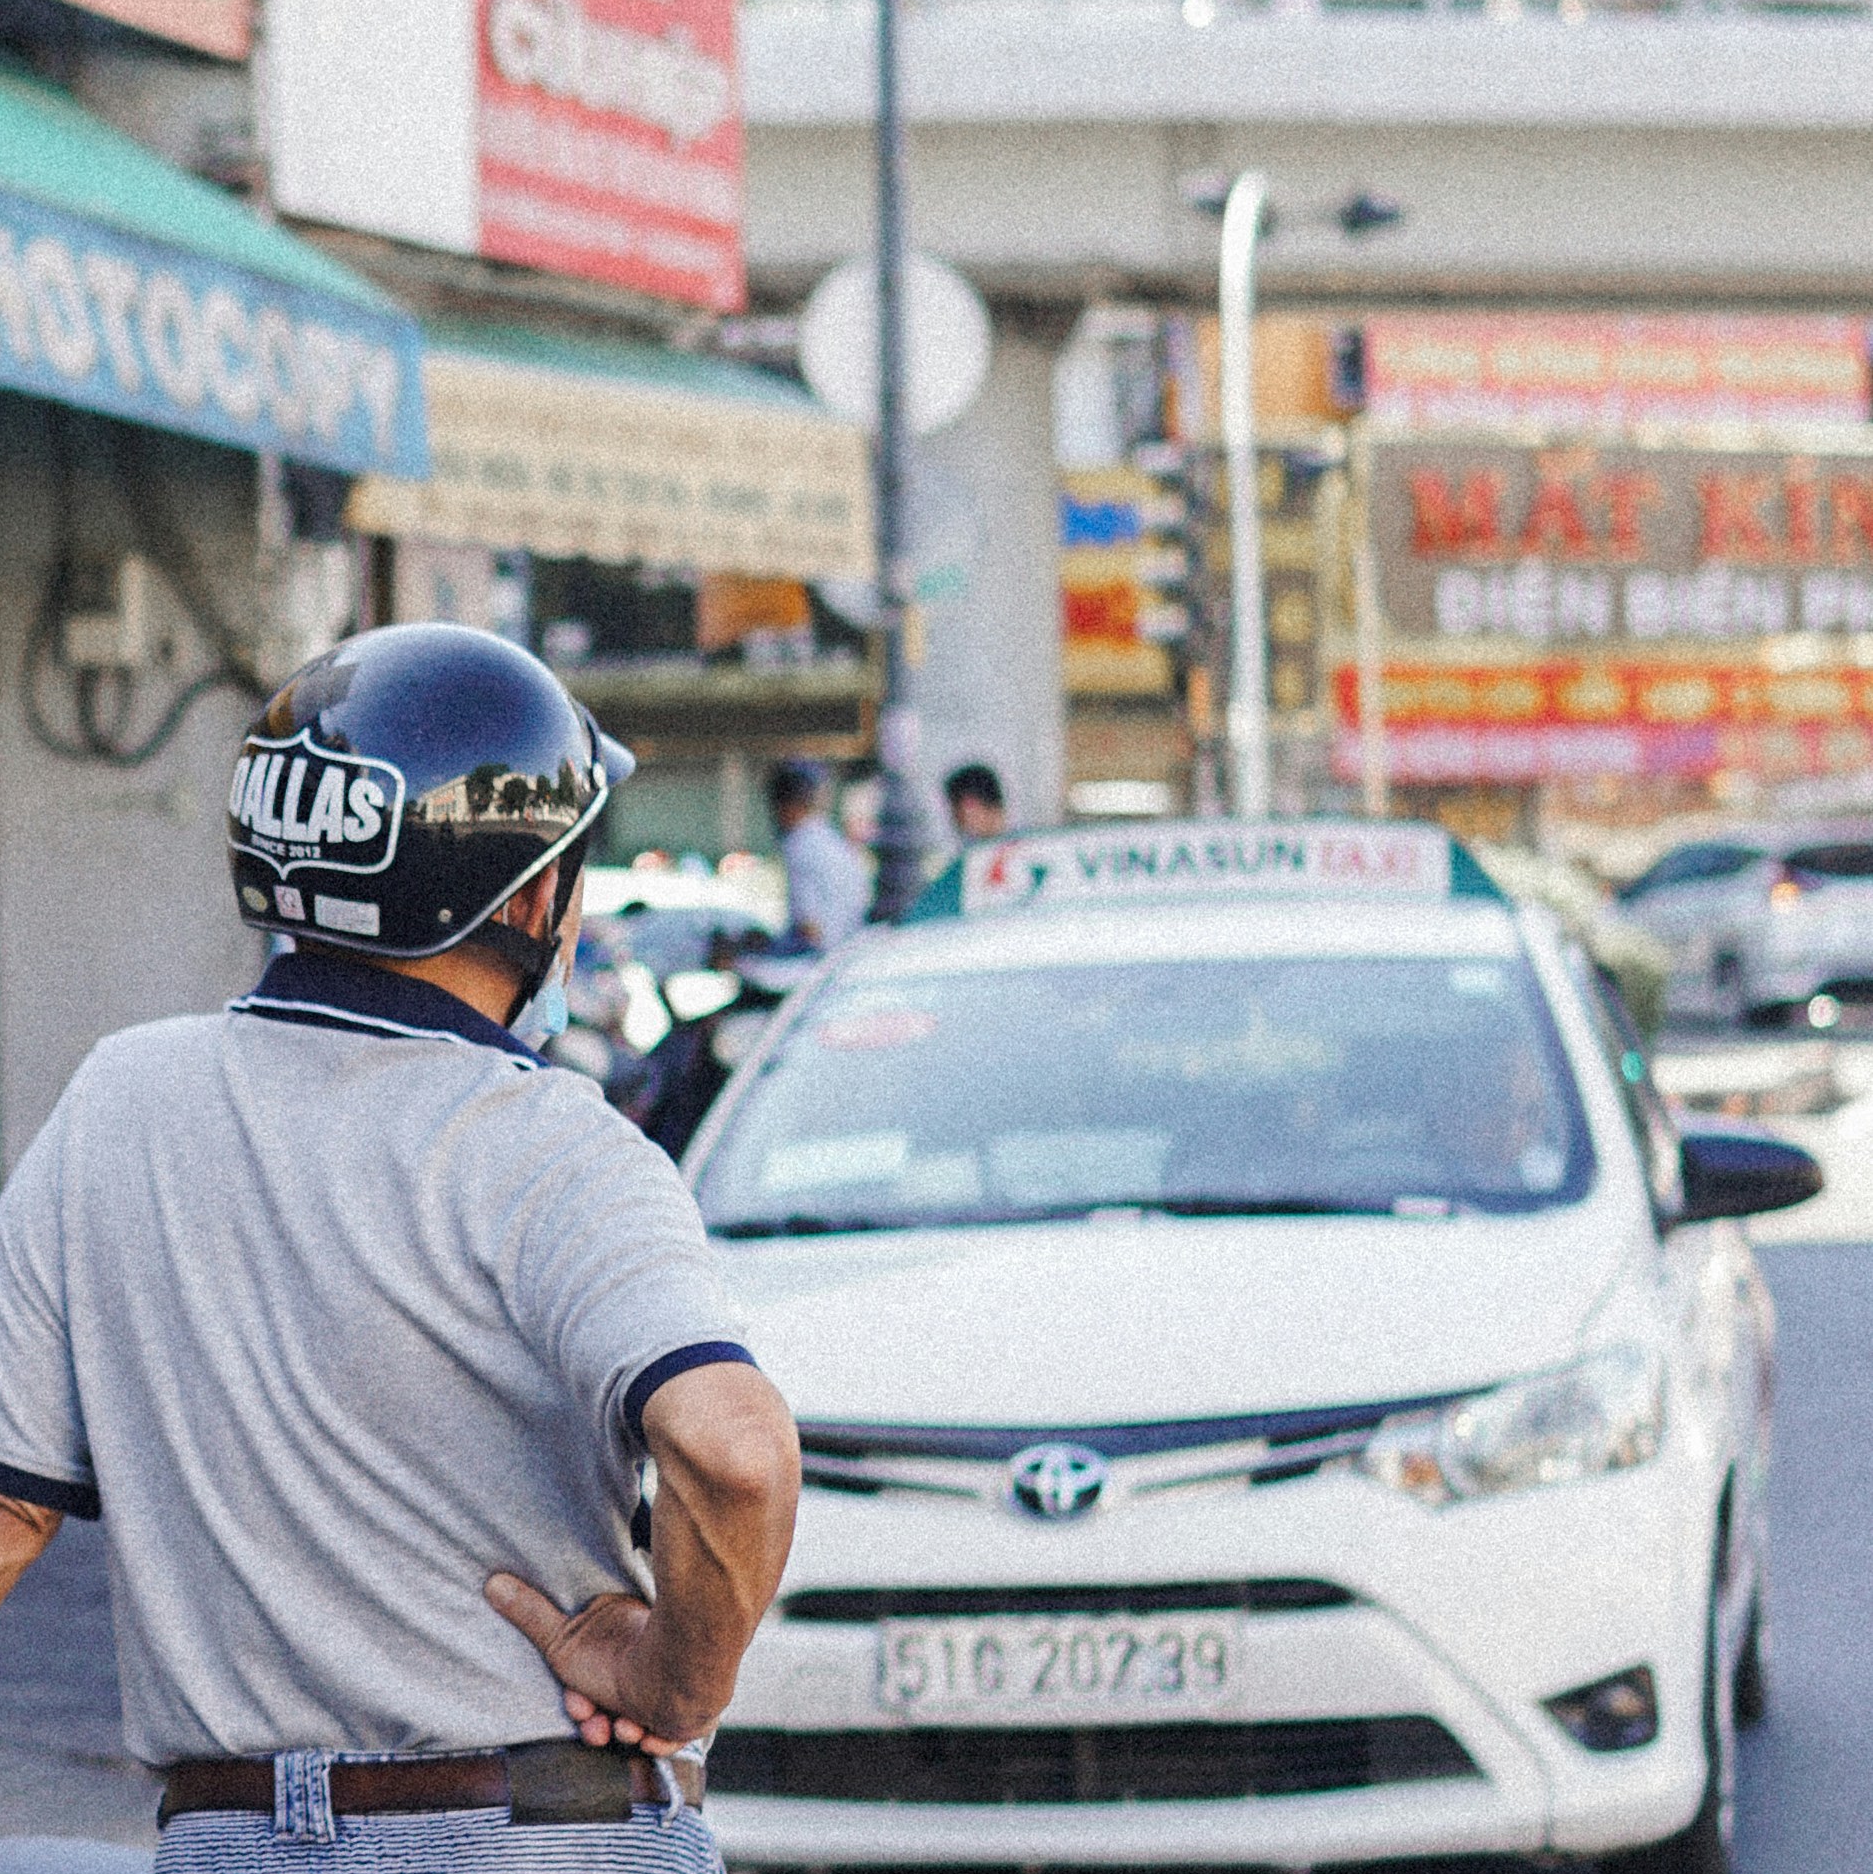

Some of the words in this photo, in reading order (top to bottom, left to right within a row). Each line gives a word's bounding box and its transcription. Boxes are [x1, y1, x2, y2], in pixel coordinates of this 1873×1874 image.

[229, 754, 384, 842] DALLAS
[1076, 837, 1306, 881] VINASUN
[1322, 838, 1418, 879] TAXI
